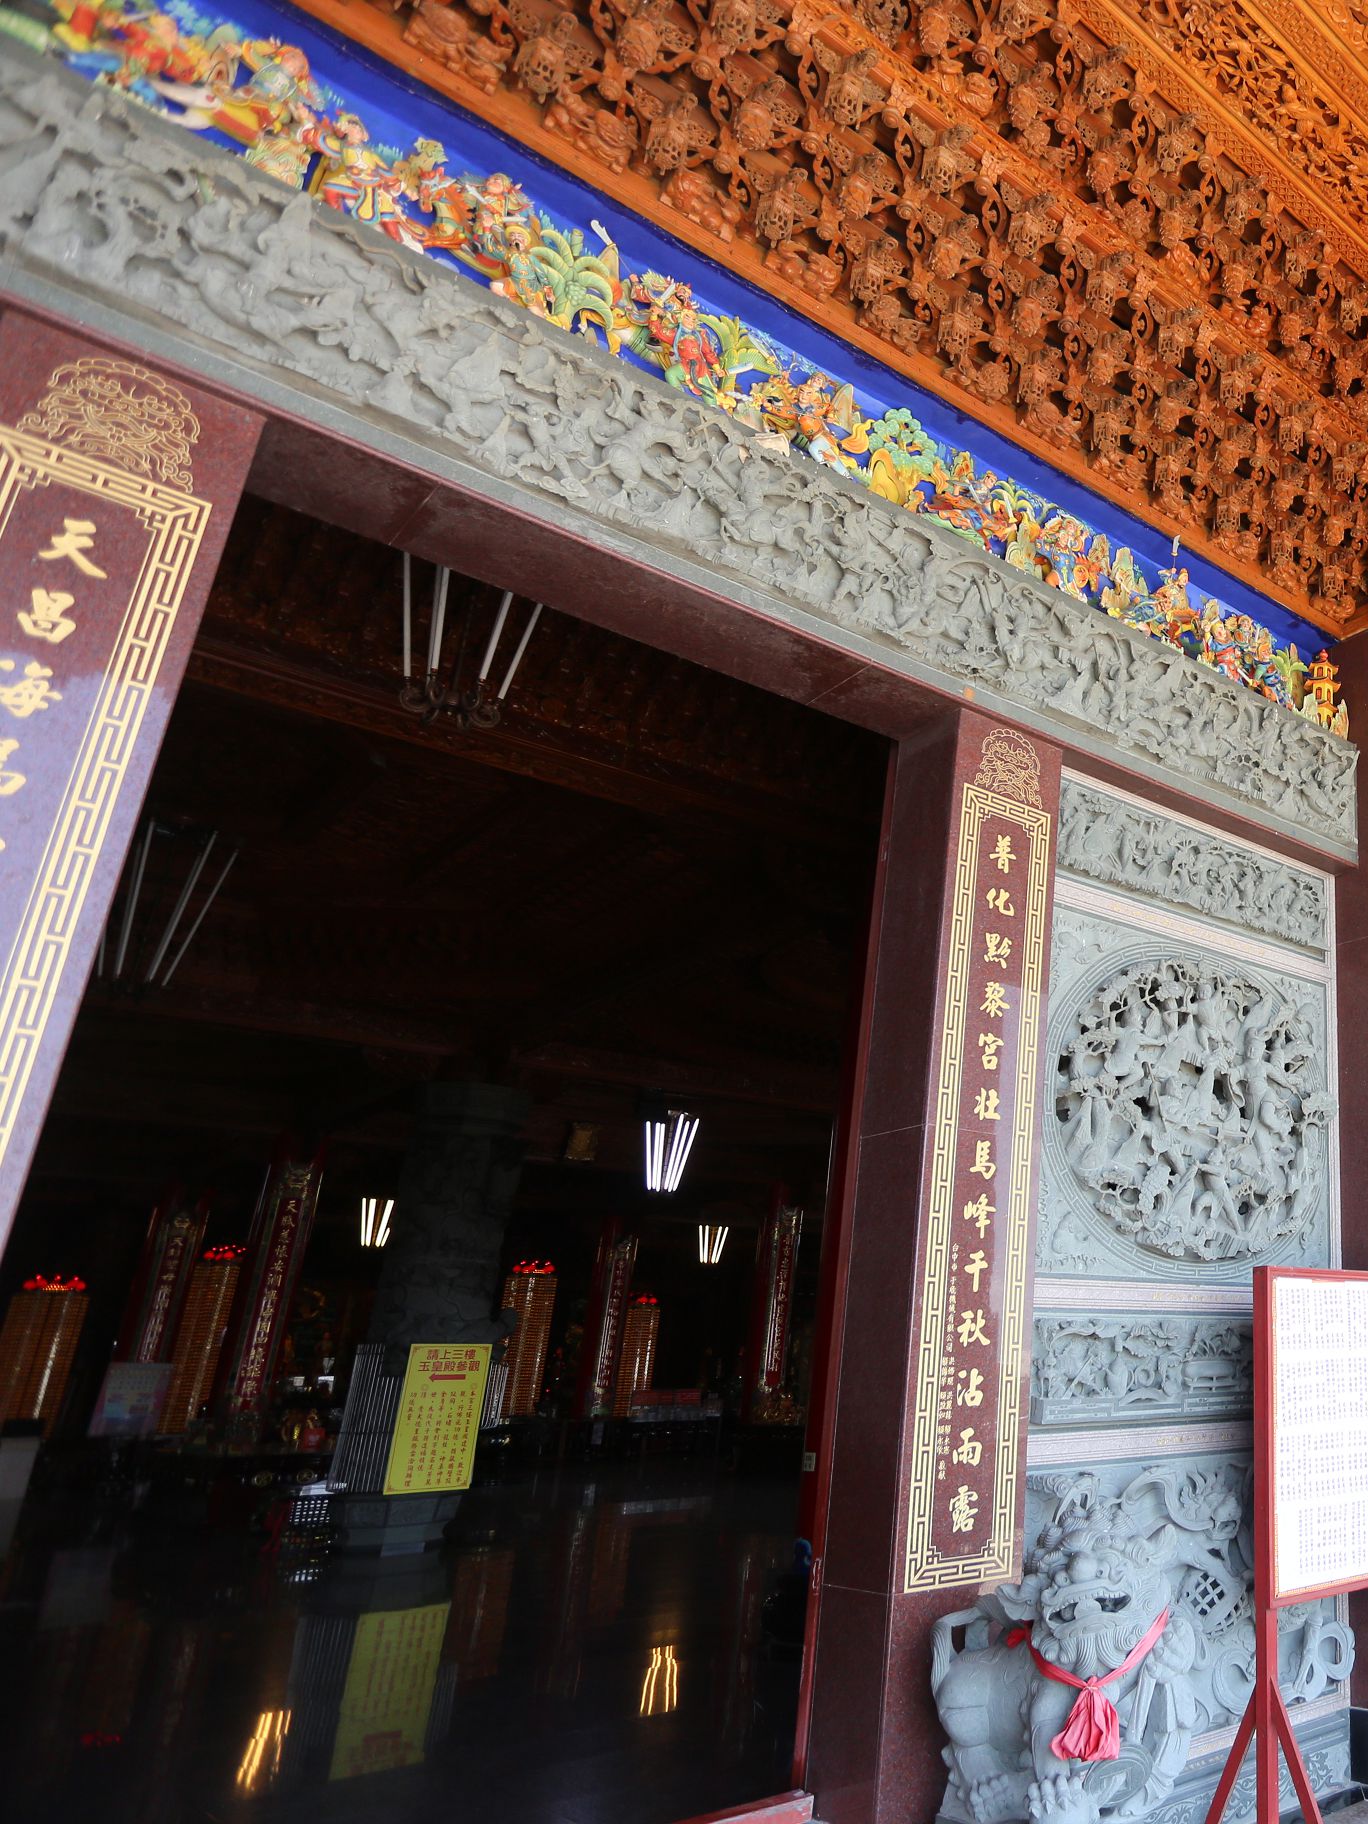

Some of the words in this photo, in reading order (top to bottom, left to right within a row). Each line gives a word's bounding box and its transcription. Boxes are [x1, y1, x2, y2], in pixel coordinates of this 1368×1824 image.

[427, 1349, 476, 1360] 請上三樓
[418, 1361, 480, 1372] 玉皇殿參觀
